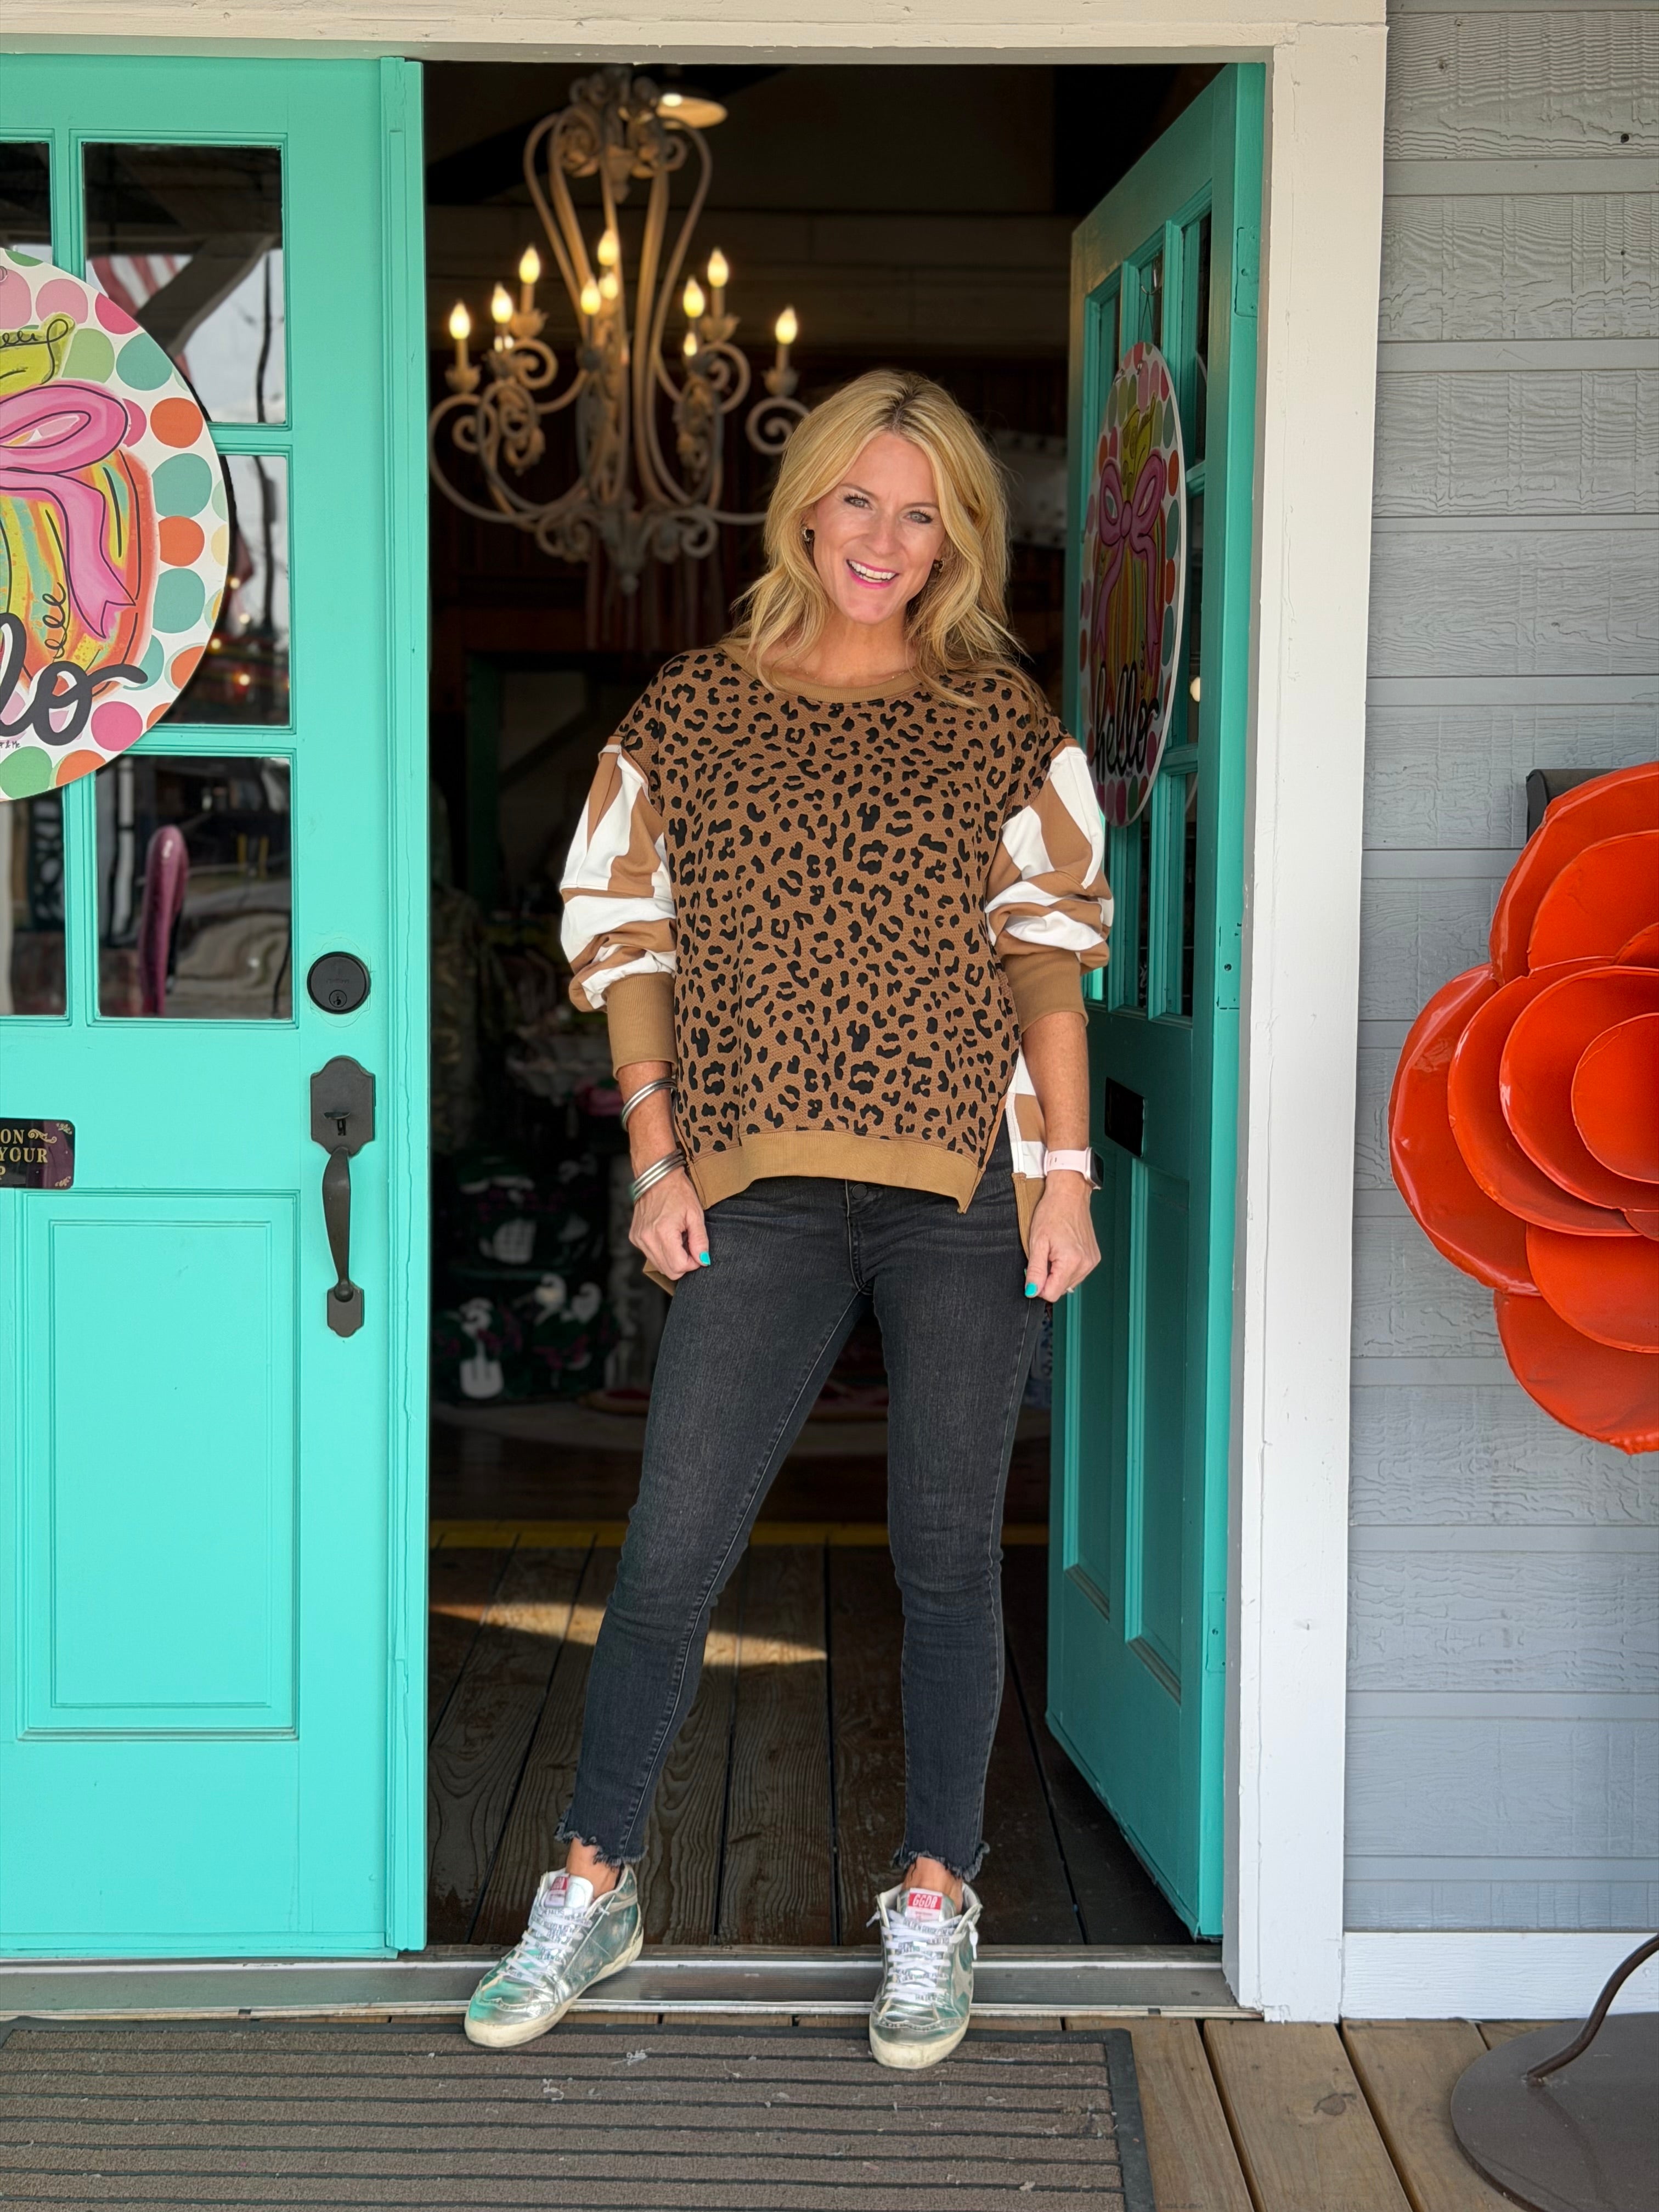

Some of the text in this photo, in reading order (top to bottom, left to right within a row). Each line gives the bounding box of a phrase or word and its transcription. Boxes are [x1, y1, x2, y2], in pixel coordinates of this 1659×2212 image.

[1090, 661, 1160, 785] hello
[0, 1128, 25, 1144] ON
[0, 1147, 48, 1163] YOUR
